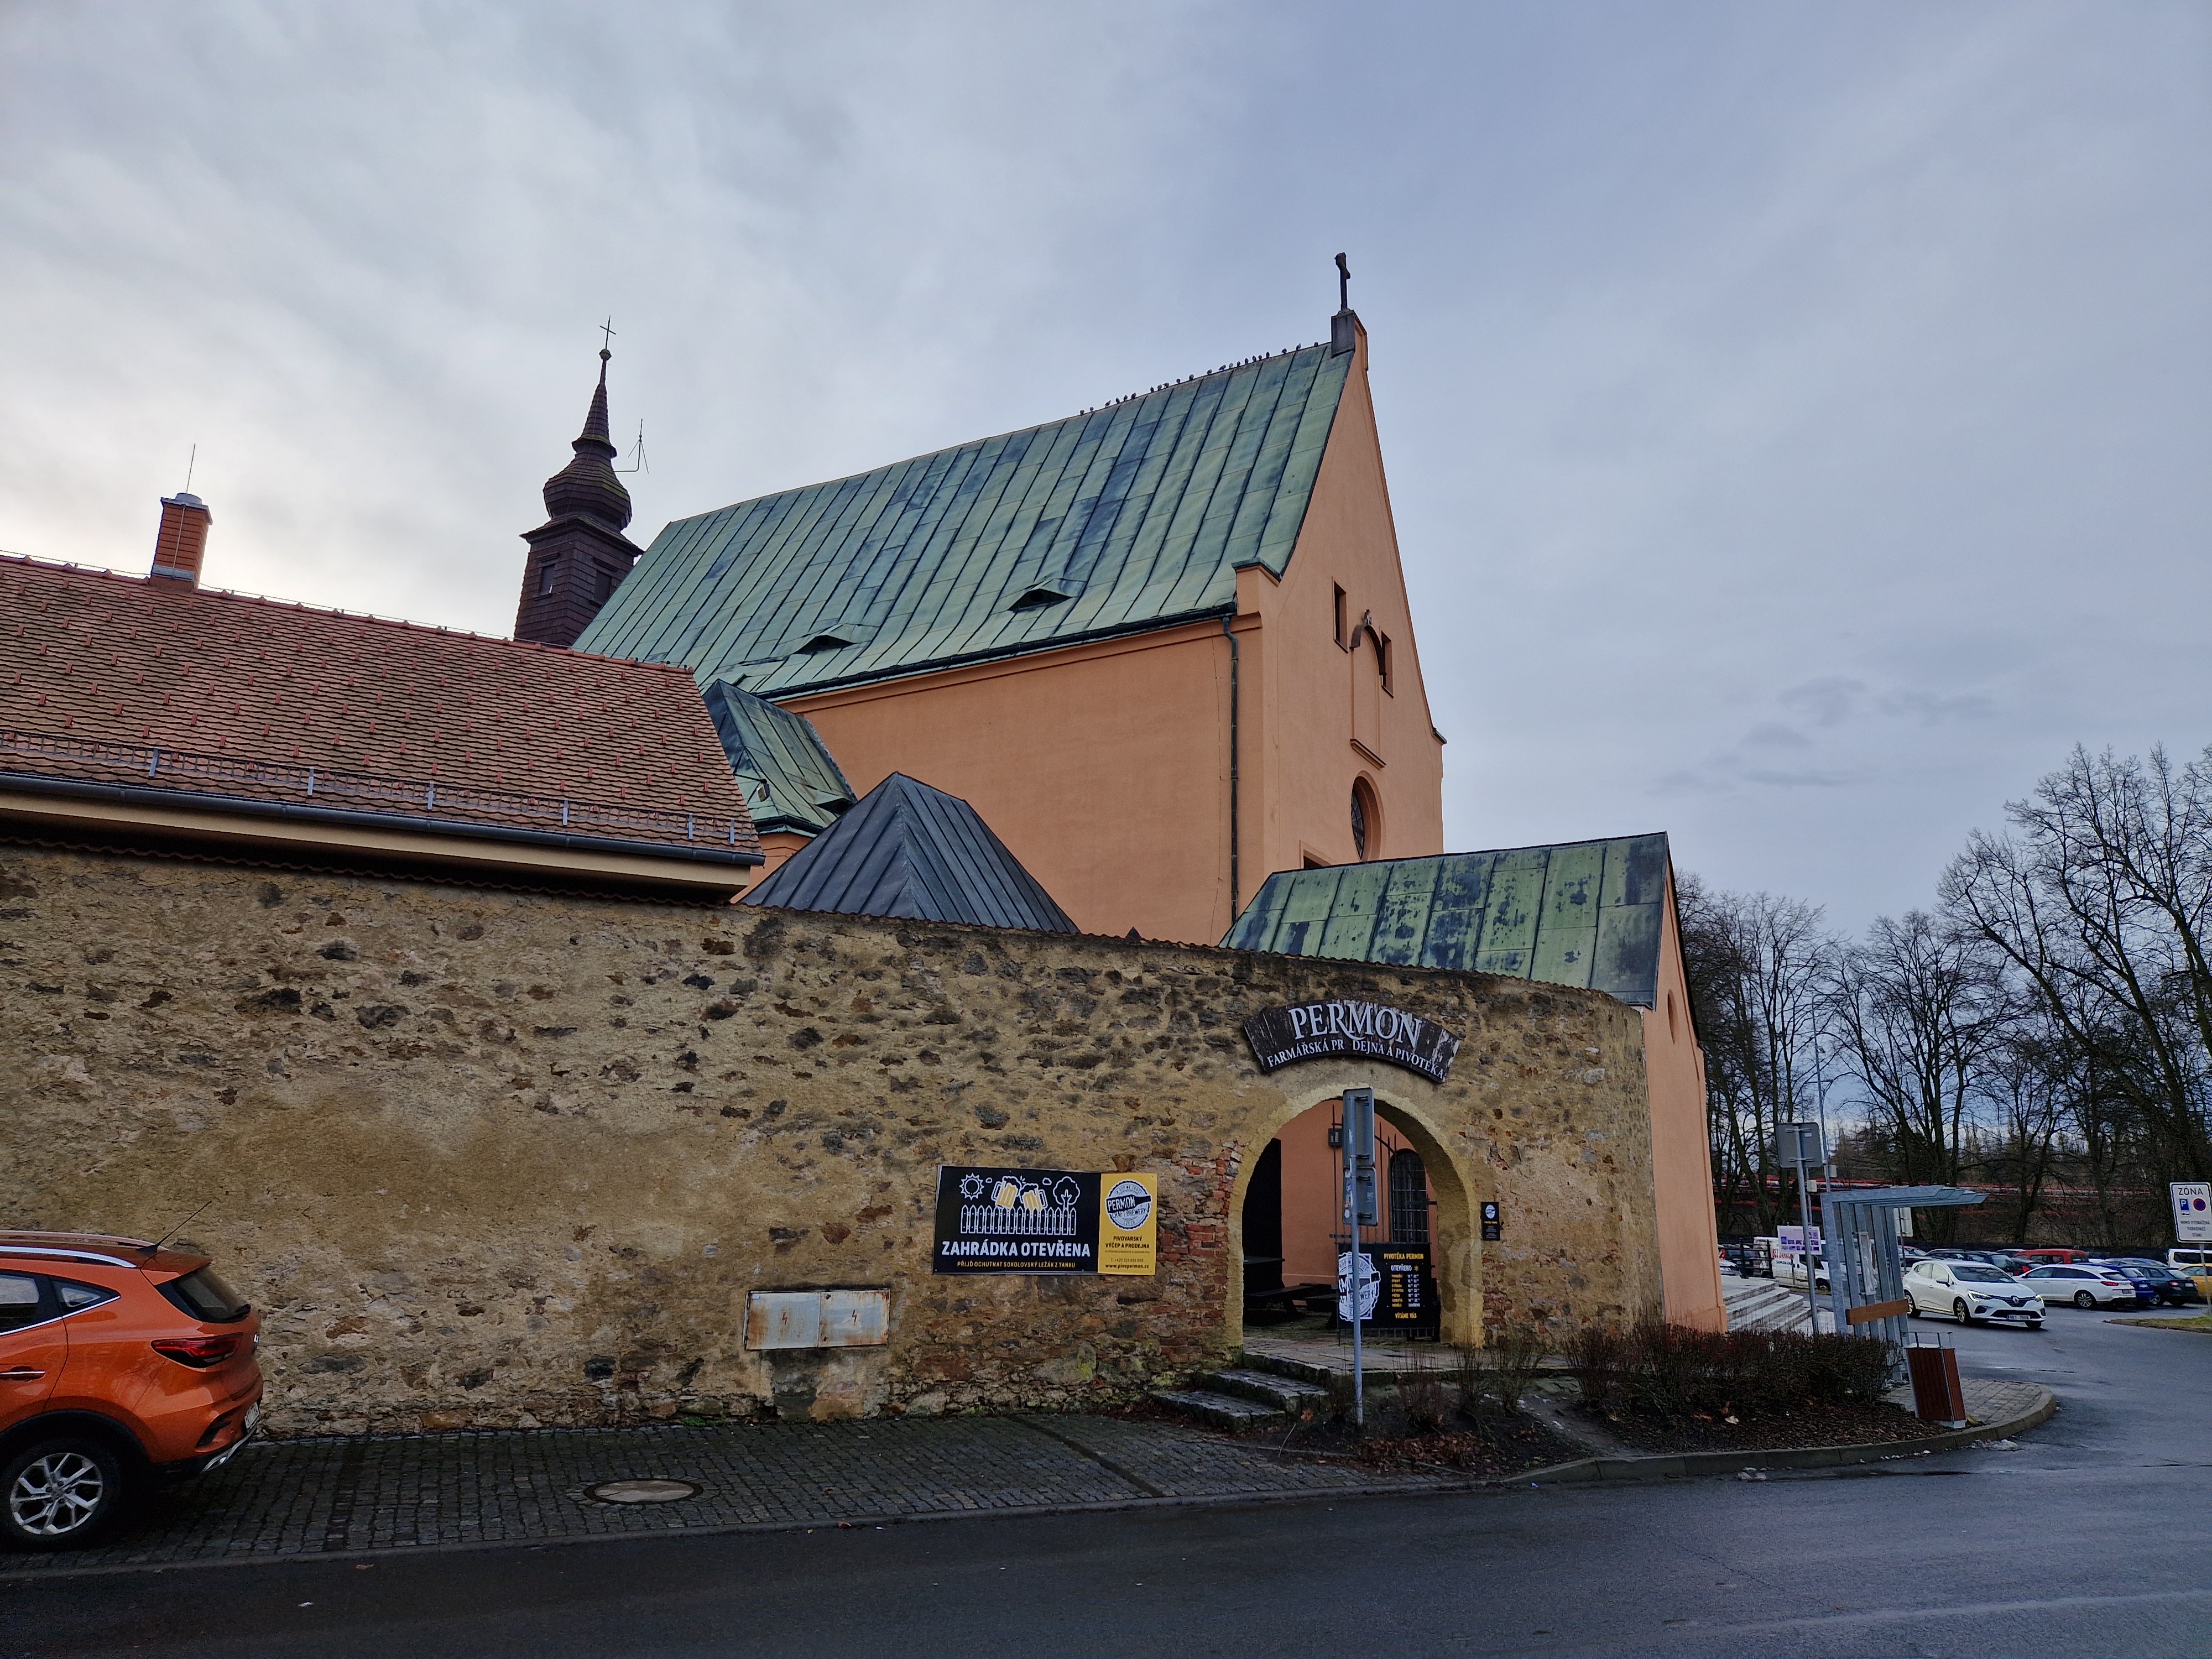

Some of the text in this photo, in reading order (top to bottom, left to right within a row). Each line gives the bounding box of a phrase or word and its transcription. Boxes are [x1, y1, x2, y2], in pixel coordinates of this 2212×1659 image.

[1288, 1004, 1423, 1048] PERMON
[1267, 1037, 1329, 1067] FARMÁŘSKÁ
[1386, 1046, 1393, 1057] A
[1395, 1047, 1443, 1079] PIVOTÉKA
[2178, 1186, 2204, 1196] ZÓNA
[1107, 1196, 1136, 1212] PERMON
[1126, 1208, 1146, 1217] BREWERY
[941, 1239, 1091, 1257] ZAHRÁDKA OTEVŘENA
